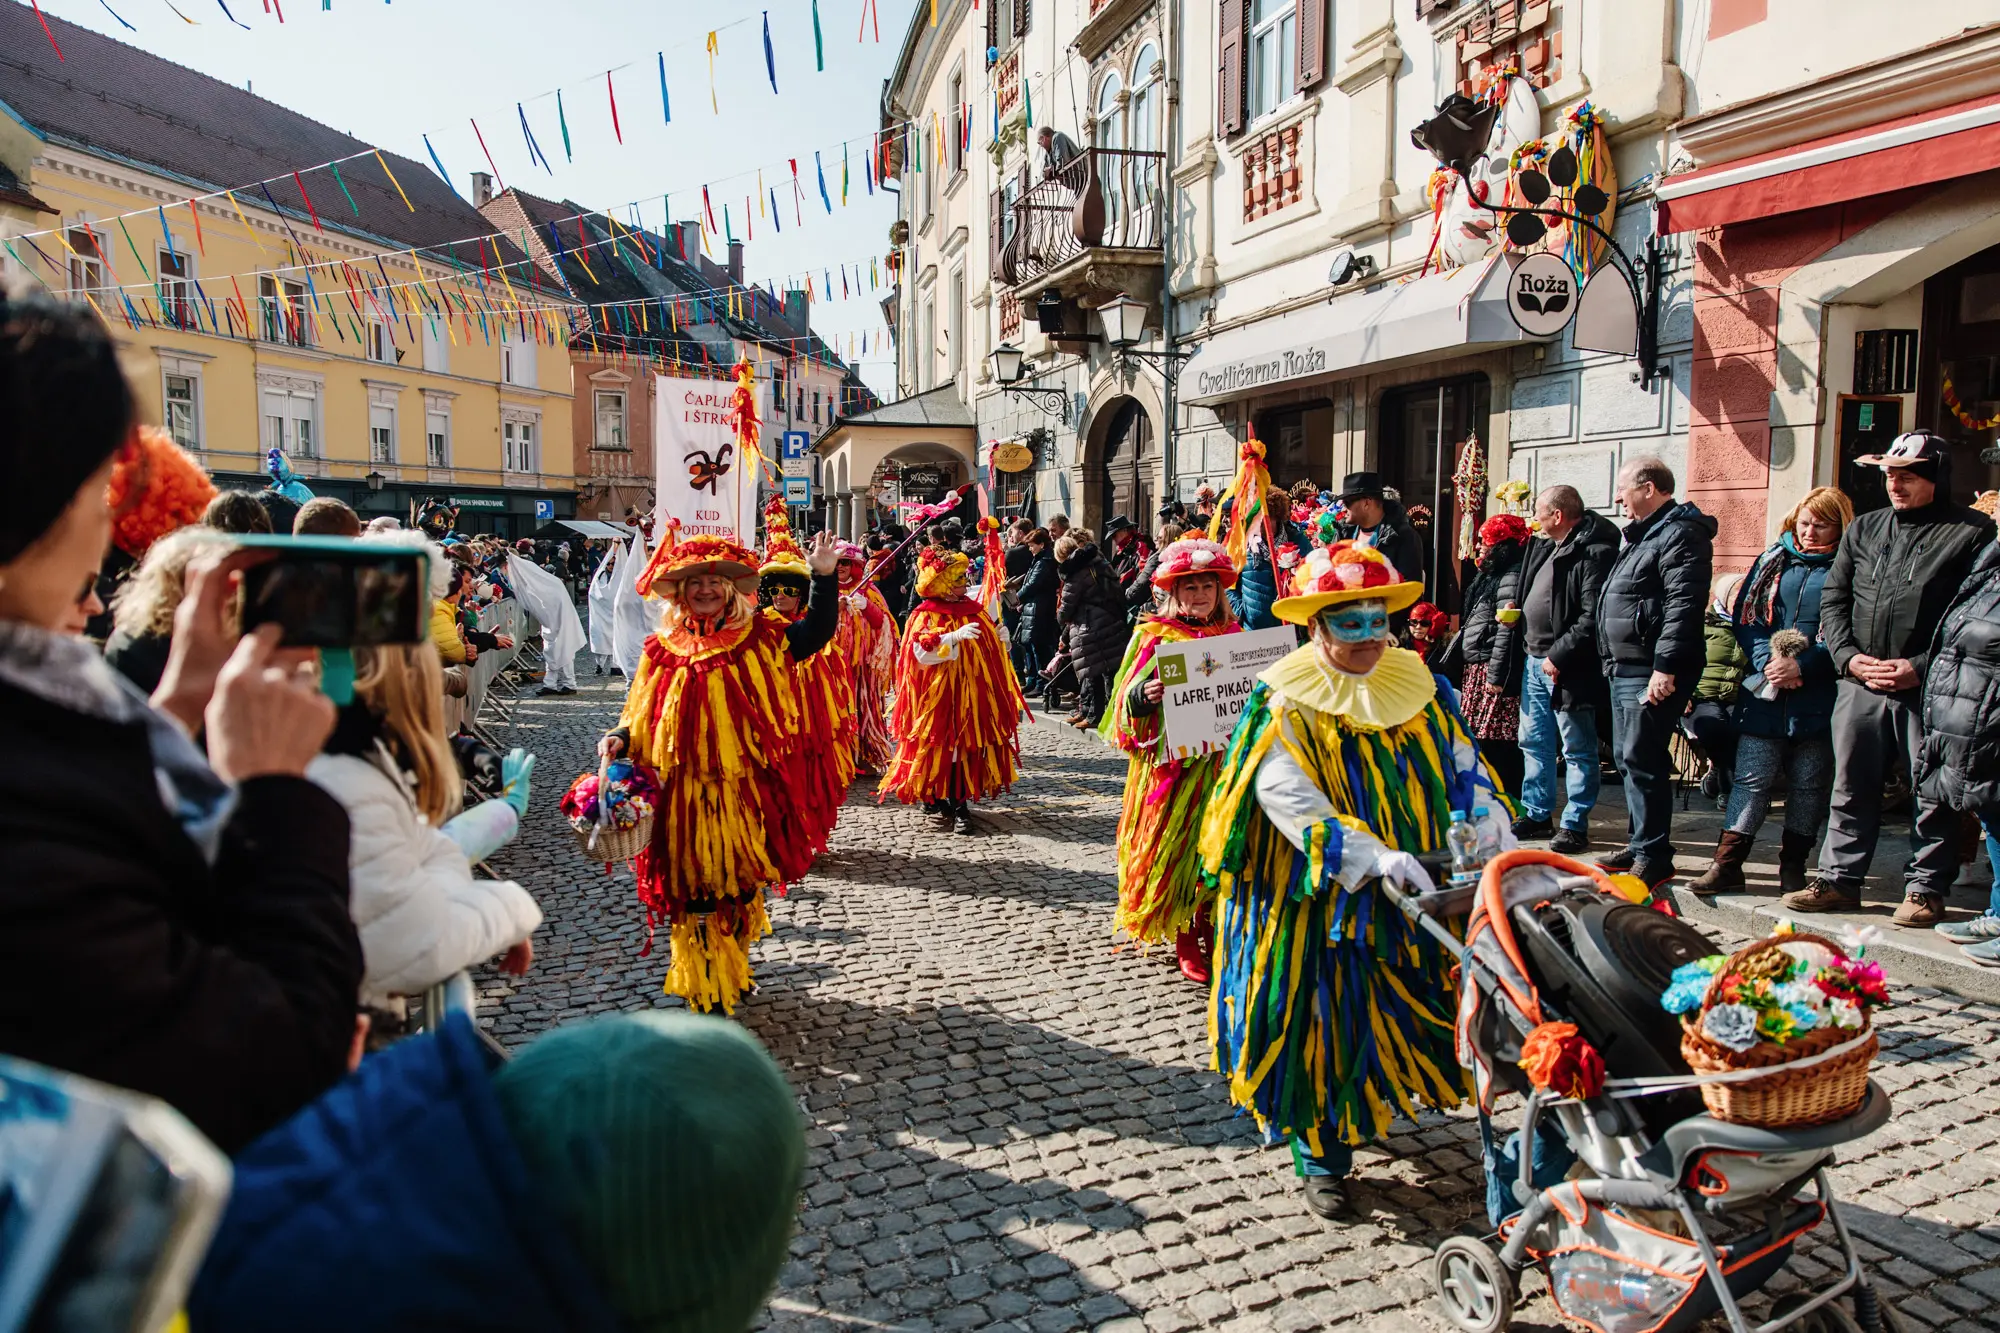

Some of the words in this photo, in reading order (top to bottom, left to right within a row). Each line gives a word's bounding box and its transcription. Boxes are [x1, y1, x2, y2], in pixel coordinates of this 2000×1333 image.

[1519, 273, 1568, 293] Roža
[1198, 360, 1280, 395] Cvetličarna
[1283, 346, 1326, 378] Roža
[684, 390, 735, 409] ČAPLJE
[685, 411, 689, 422] I
[789, 434, 804, 455] P
[536, 501, 547, 516] P
[695, 510, 720, 521] KUD
[1163, 664, 1182, 679] 32.
[1173, 687, 1215, 707] LAFRE,
[1216, 676, 1253, 699] PIKAČI
[1215, 702, 1228, 718] IN
[1213, 721, 1237, 734] Čakov
